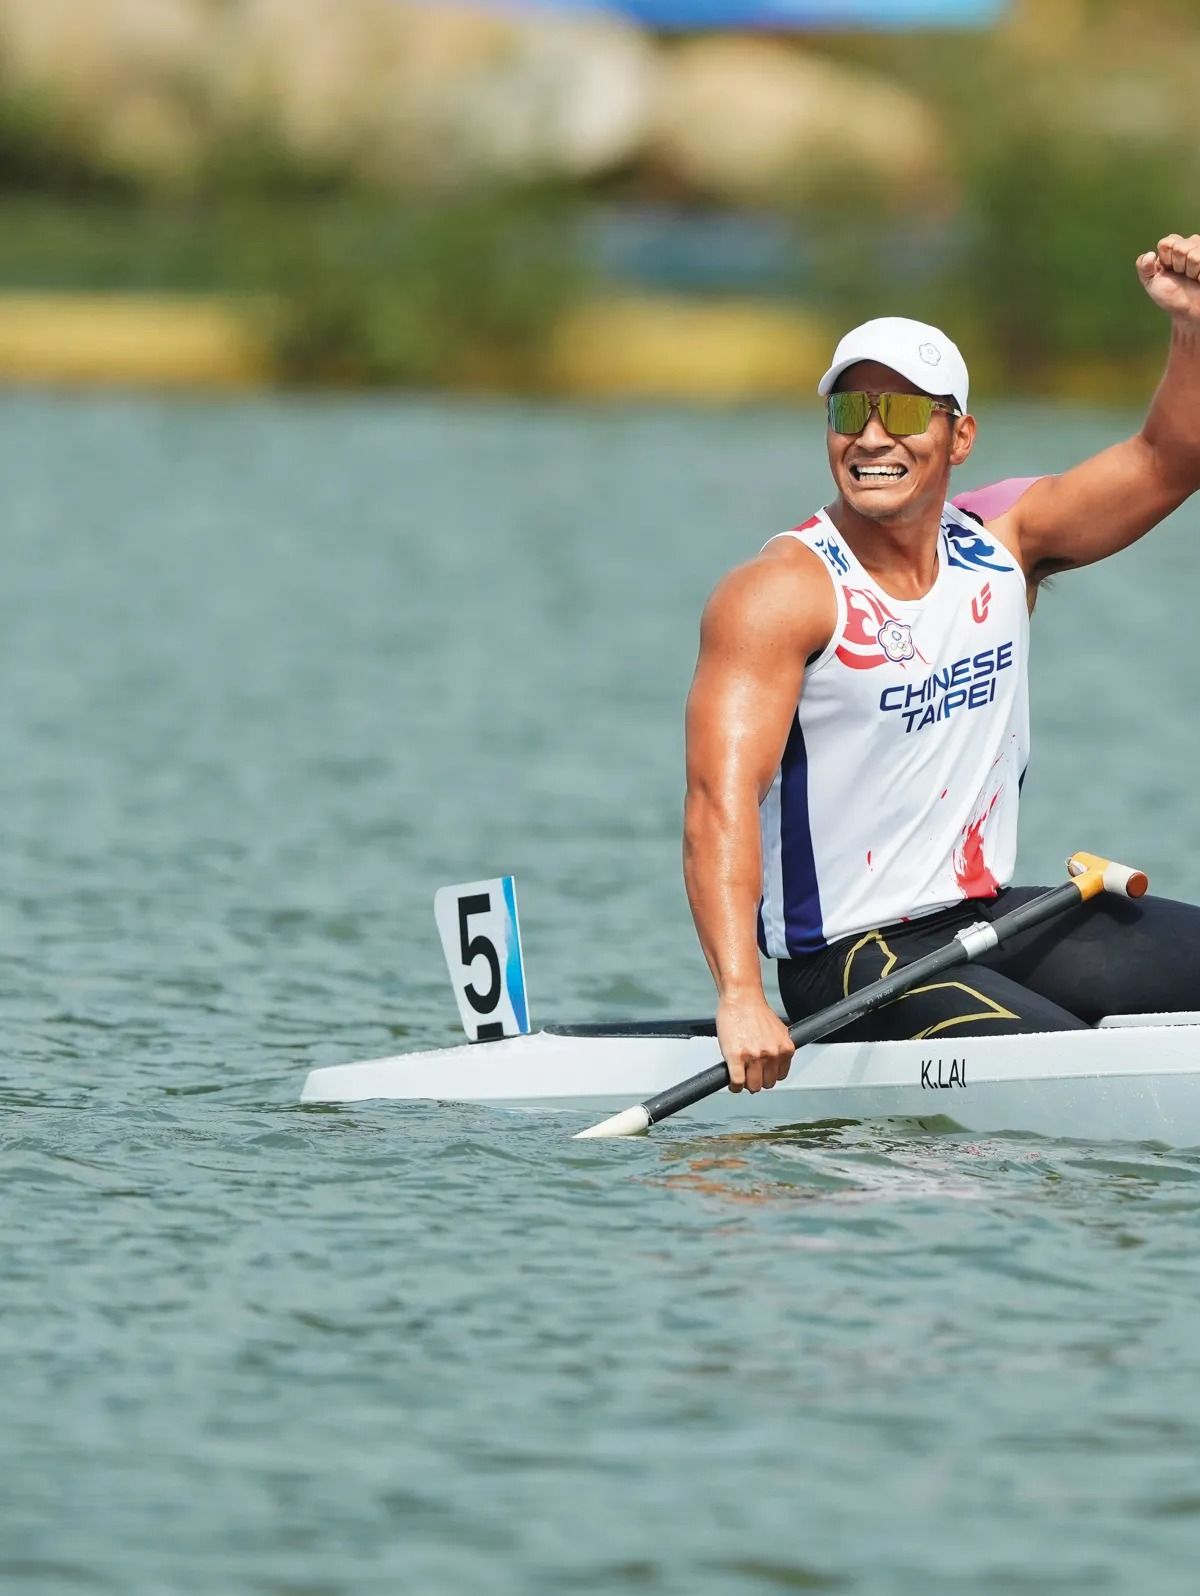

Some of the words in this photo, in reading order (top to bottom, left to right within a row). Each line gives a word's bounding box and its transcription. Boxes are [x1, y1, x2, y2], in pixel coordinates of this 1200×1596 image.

[879, 641, 1013, 712] CHINESE
[901, 677, 997, 734] TAIPEI
[457, 893, 502, 1015] 5
[921, 1059, 967, 1089] K.LAI
